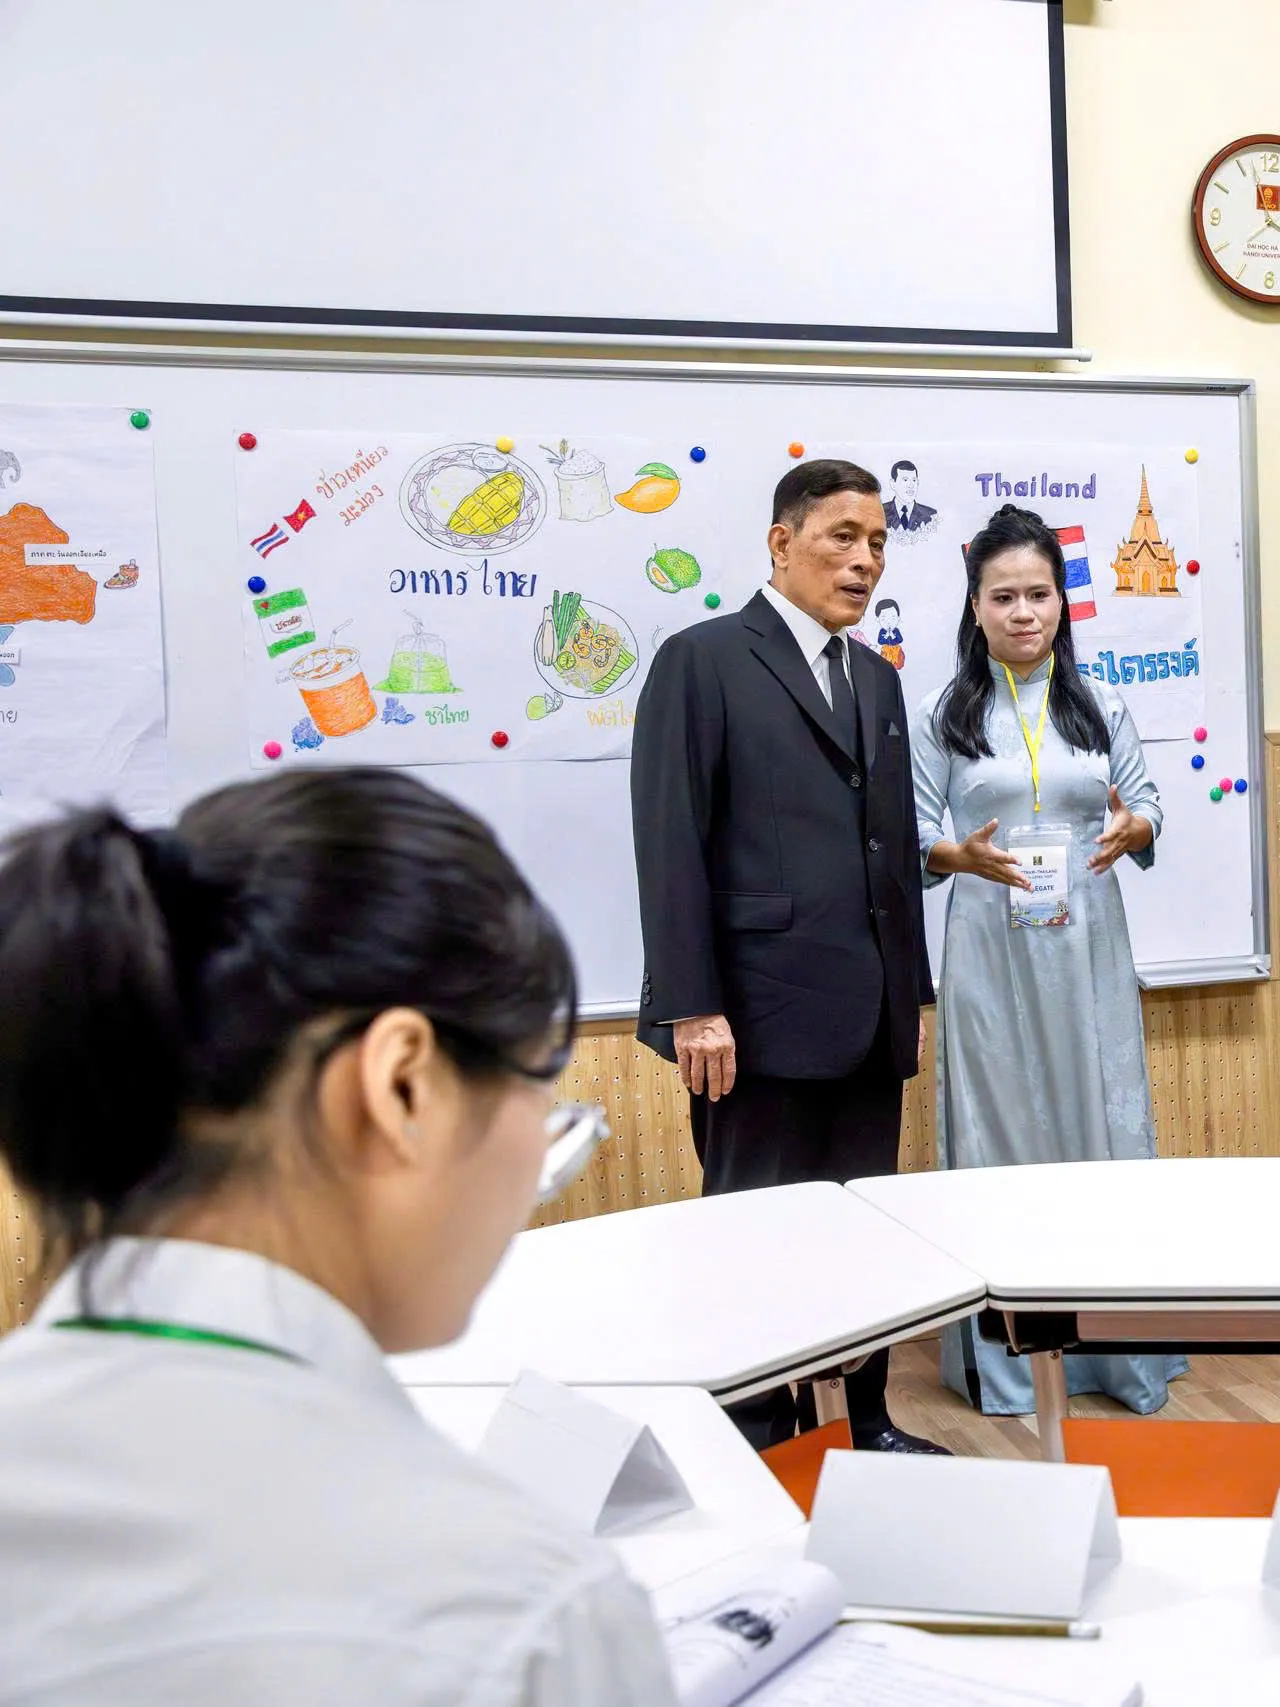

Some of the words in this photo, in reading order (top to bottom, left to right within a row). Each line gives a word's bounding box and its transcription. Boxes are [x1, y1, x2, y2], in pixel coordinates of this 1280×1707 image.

[1260, 152, 1279, 173] 12
[1209, 207, 1221, 226] 9
[1263, 271, 1275, 289] 6
[975, 472, 1096, 499] Thailand
[425, 703, 469, 725] ชาไทย
